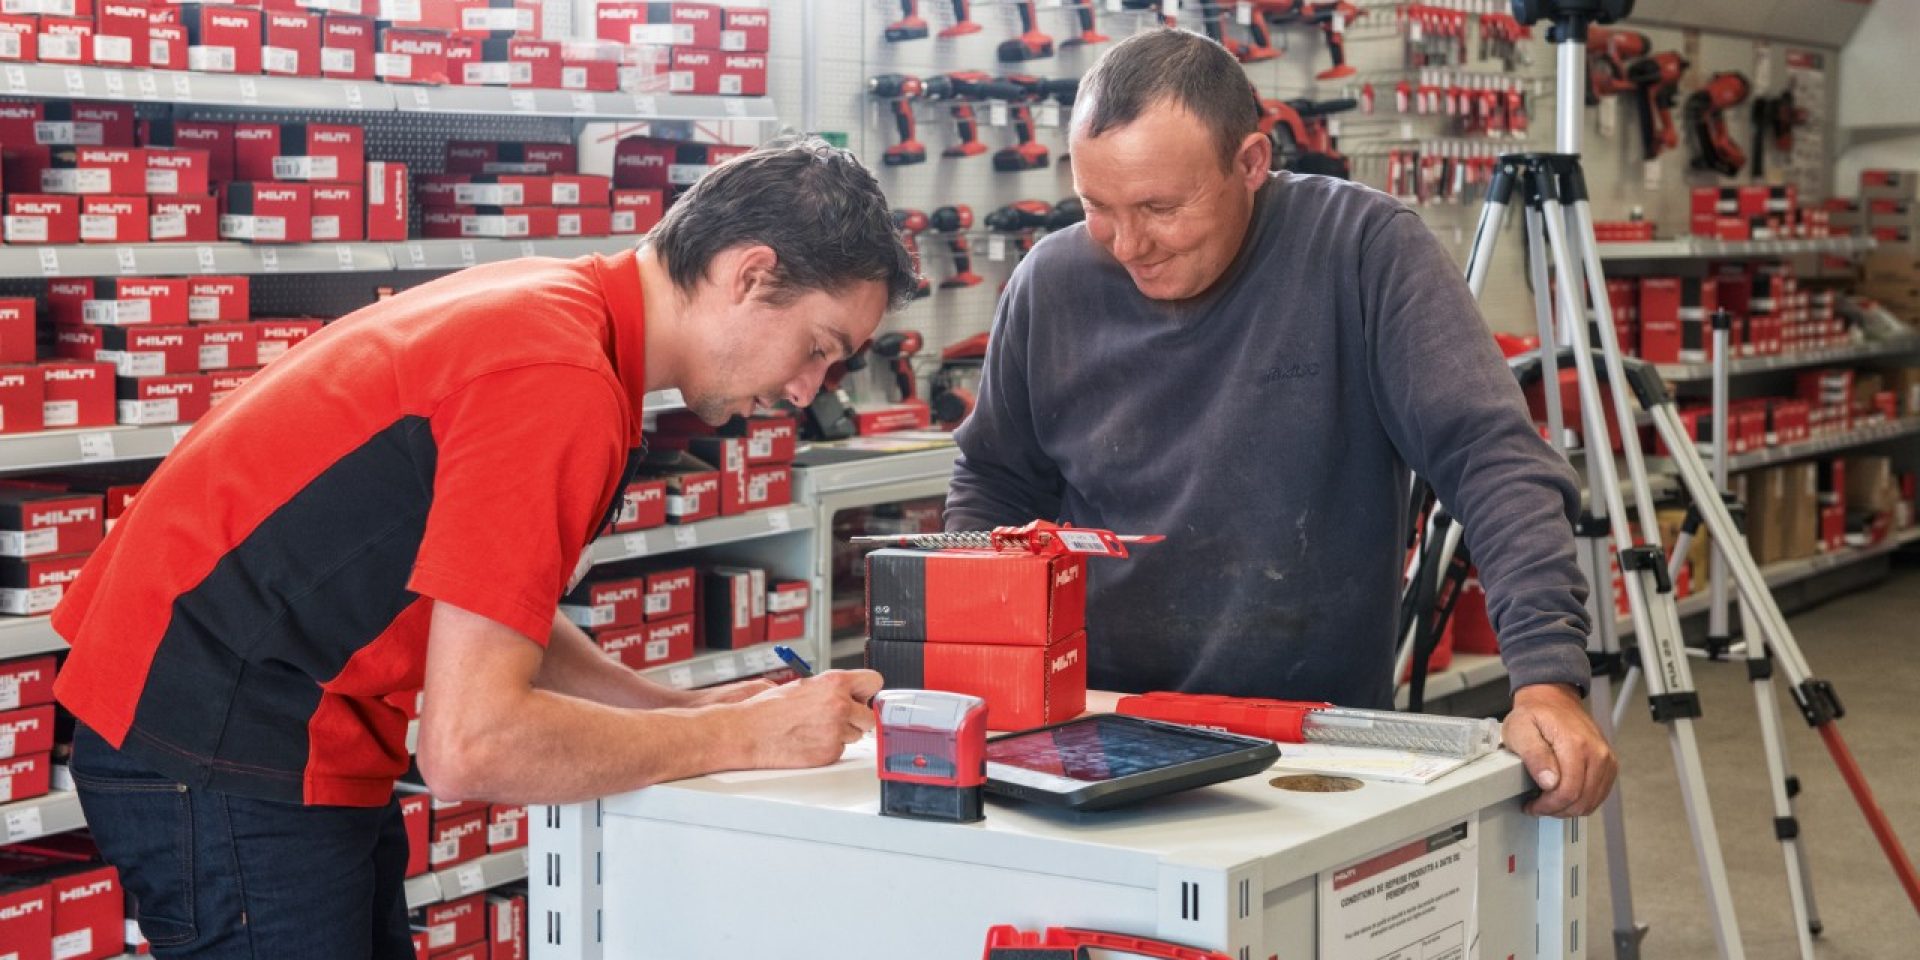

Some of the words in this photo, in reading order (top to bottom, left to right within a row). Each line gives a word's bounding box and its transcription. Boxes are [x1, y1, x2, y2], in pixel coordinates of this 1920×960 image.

[105, 5, 147, 18] HILTI
[598, 8, 638, 19] HILTI
[675, 8, 709, 20] HILTI
[211, 15, 249, 28] HILTI
[272, 16, 308, 28] HILTI
[730, 14, 767, 27] HILTI
[329, 23, 364, 36] HILTI
[391, 39, 442, 55] HILTI
[513, 46, 550, 58] HILTI
[677, 54, 709, 65] HILTI
[725, 56, 764, 69] HILTI
[178, 129, 218, 139] HILTI
[234, 128, 272, 139] HILTI
[314, 132, 351, 143] HILTI
[82, 151, 129, 163] HILTI
[147, 156, 192, 168] HILTI
[618, 155, 664, 167] HILTI
[257, 190, 297, 201] HILTI
[313, 189, 350, 200] HILTI
[617, 194, 651, 205] HILTI
[15, 203, 61, 214] HILTI
[87, 203, 132, 214] HILTI
[157, 203, 201, 215] HILTI
[121, 285, 169, 297] HILTI
[194, 284, 235, 296] HILTI
[203, 331, 243, 343] HILTI
[263, 327, 308, 338] HILTI
[136, 335, 183, 346] HILTI
[45, 368, 96, 381] HILTI
[147, 383, 193, 396] HILTI
[686, 479, 718, 496] HILTI
[32, 506, 96, 527] HILTI
[1055, 563, 1080, 588] HILTI
[653, 577, 690, 592] HILTI
[596, 587, 638, 604] HILTI
[650, 623, 690, 640] HILTI
[603, 633, 642, 651] HILTI
[1052, 649, 1078, 674] HILTI
[60, 879, 112, 903] HILTI
[434, 902, 472, 923] HILTI
